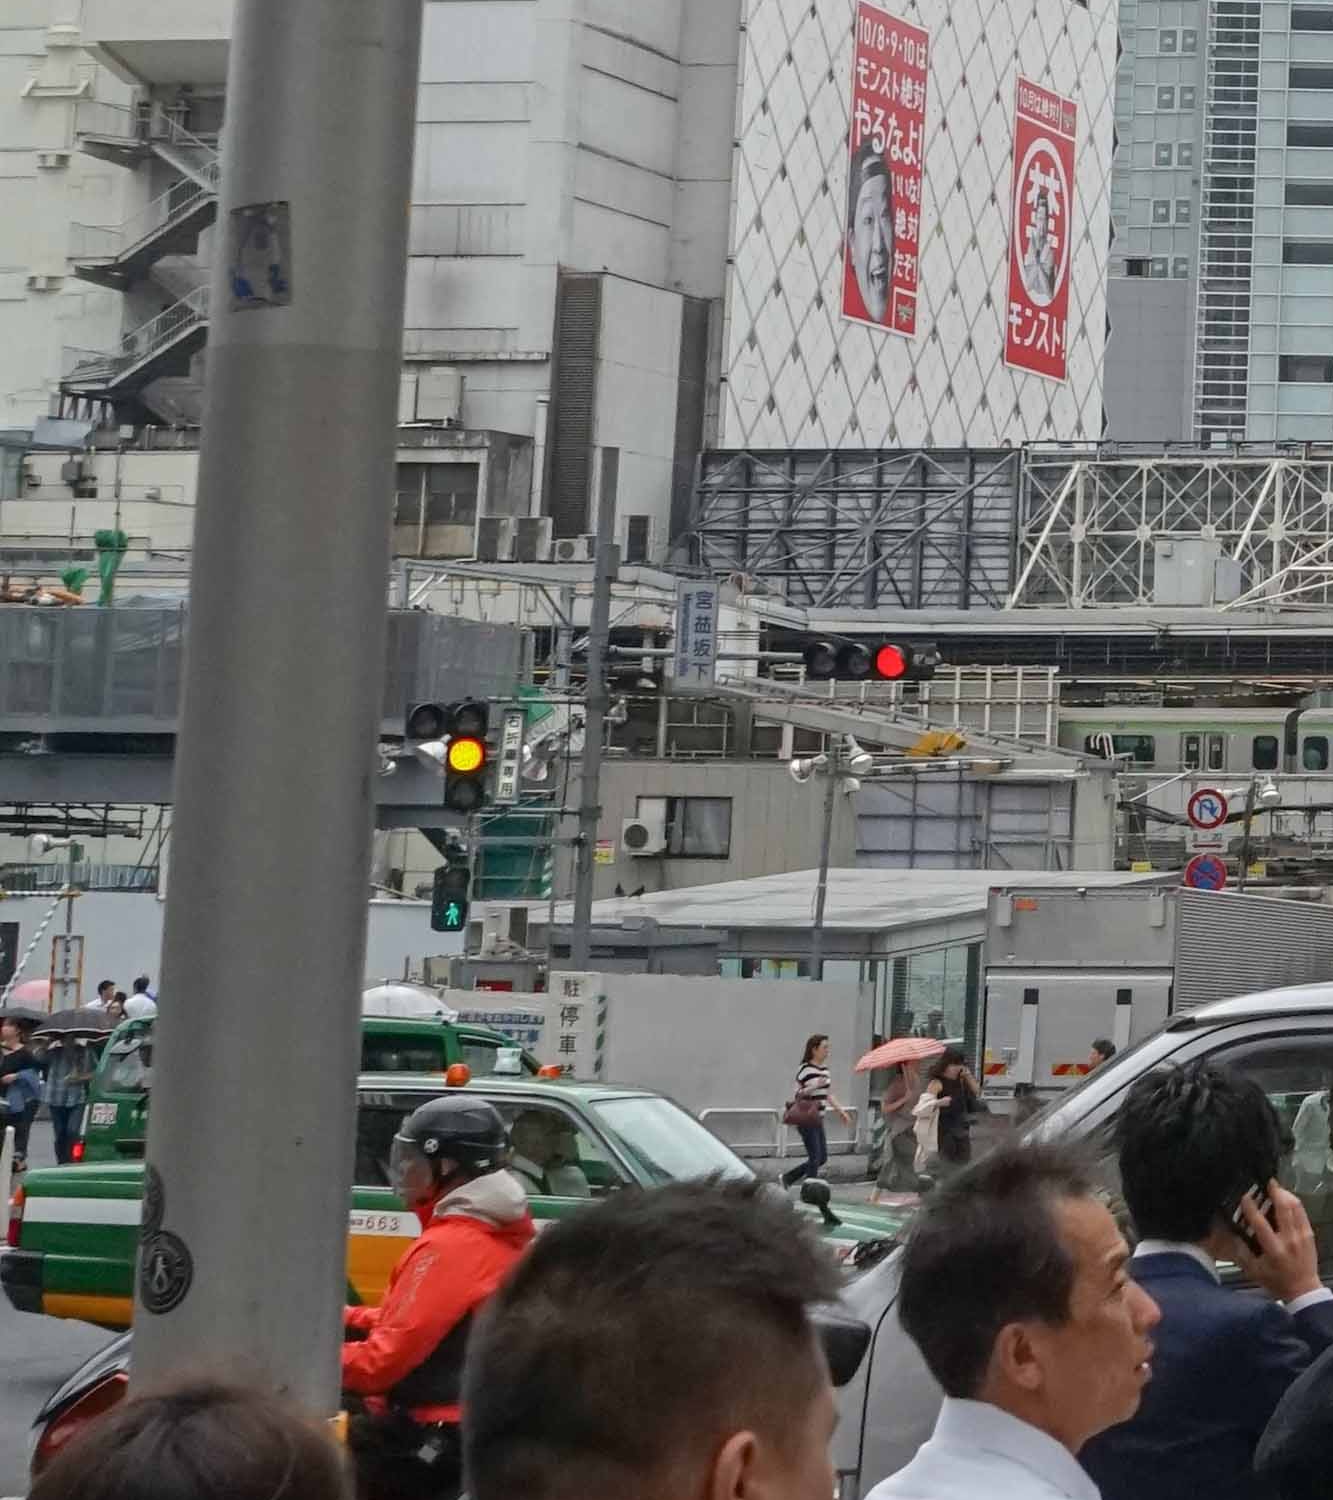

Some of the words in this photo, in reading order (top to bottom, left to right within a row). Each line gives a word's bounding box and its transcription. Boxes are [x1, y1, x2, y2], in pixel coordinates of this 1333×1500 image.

[856, 56, 925, 113] モンスト絶対
[854, 98, 924, 170] やるなよ!
[893, 207, 919, 243] 絶対
[1008, 301, 1067, 361] モンスト!
[557, 976, 581, 1072] 駐停車
